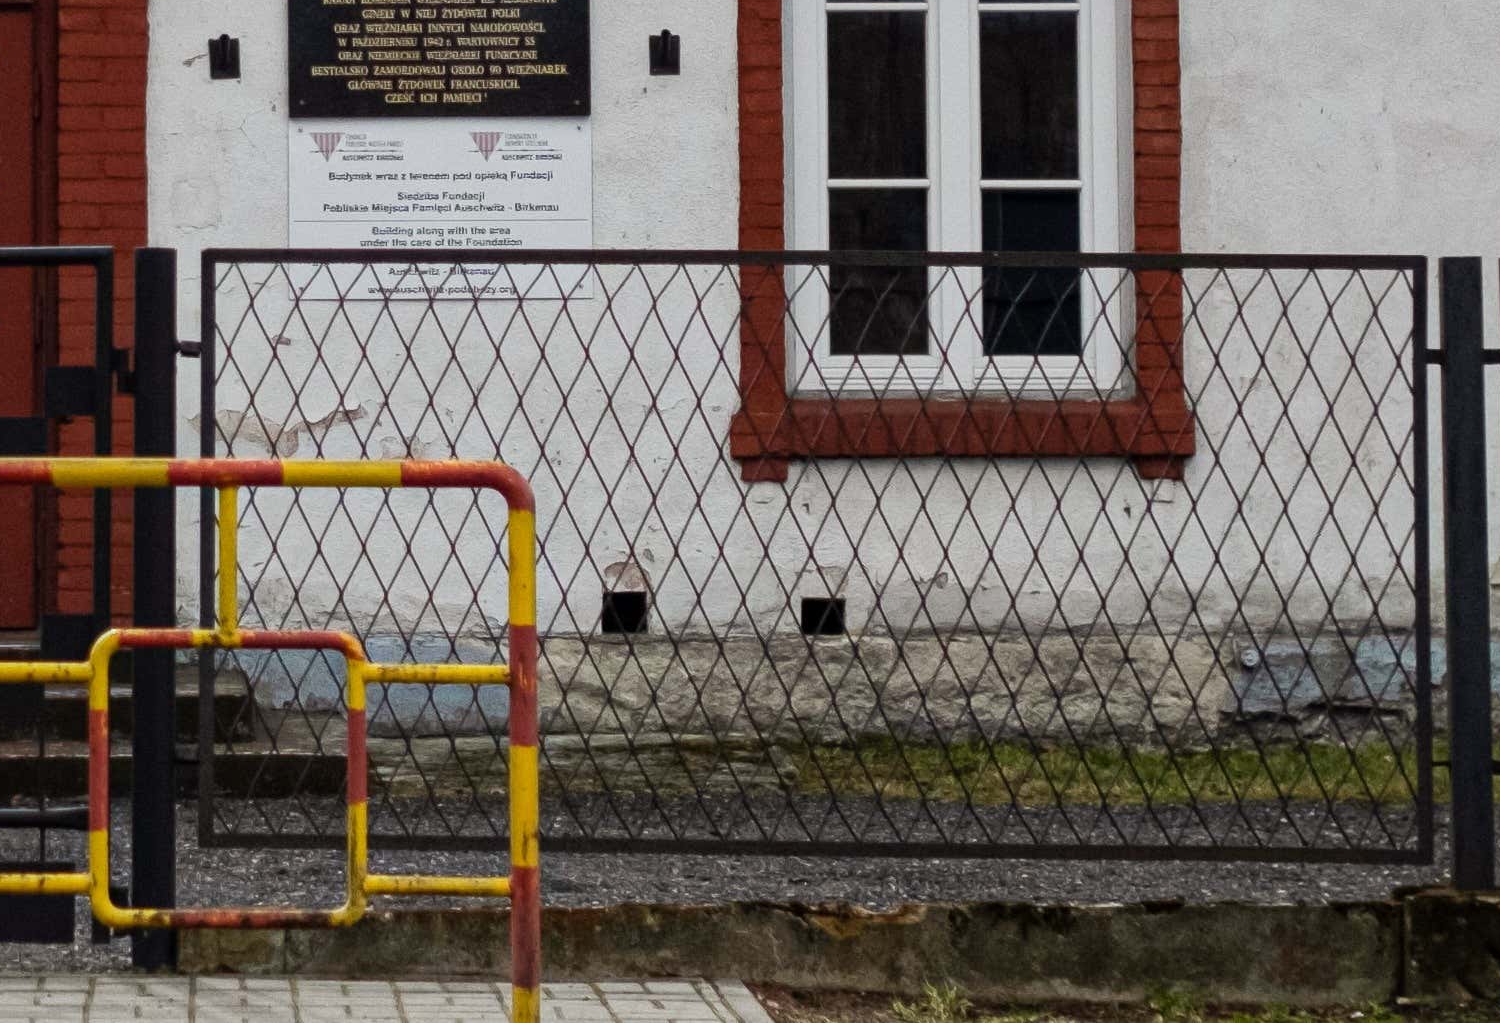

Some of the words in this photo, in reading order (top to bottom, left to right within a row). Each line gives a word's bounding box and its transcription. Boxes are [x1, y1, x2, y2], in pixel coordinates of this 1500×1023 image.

[400, 9, 411, 19] W
[415, 9, 436, 19] NIEJ
[492, 8, 520, 18] POLKI
[334, 23, 360, 34] ORAZ
[428, 23, 465, 33] INNYCH
[338, 38, 347, 47] W
[457, 37, 520, 46] WARTOWNICY
[525, 37, 535, 46] SS
[338, 51, 362, 61] ORAZ
[368, 51, 420, 61] NIEMIECKIE
[486, 50, 538, 60] FUNKCYJNE
[312, 66, 368, 76] BESTIALSKO
[373, 65, 445, 76] ZAMORDOWALI
[489, 65, 501, 74] 90
[420, 93, 438, 103] ICH
[453, 171, 471, 181] pod
[511, 170, 553, 181] Fundacji
[442, 191, 485, 202] Fundacji
[372, 203, 409, 214] Miejsca
[454, 203, 505, 212] Auschwitz
[515, 202, 559, 211] Birkenau
[372, 226, 413, 236] Building
[417, 226, 443, 236] along
[448, 226, 467, 235] with
[471, 226, 485, 235] the
[392, 238, 407, 246] the
[435, 238, 445, 246] of
[448, 238, 462, 246] the
[466, 237, 522, 246] Foundation
